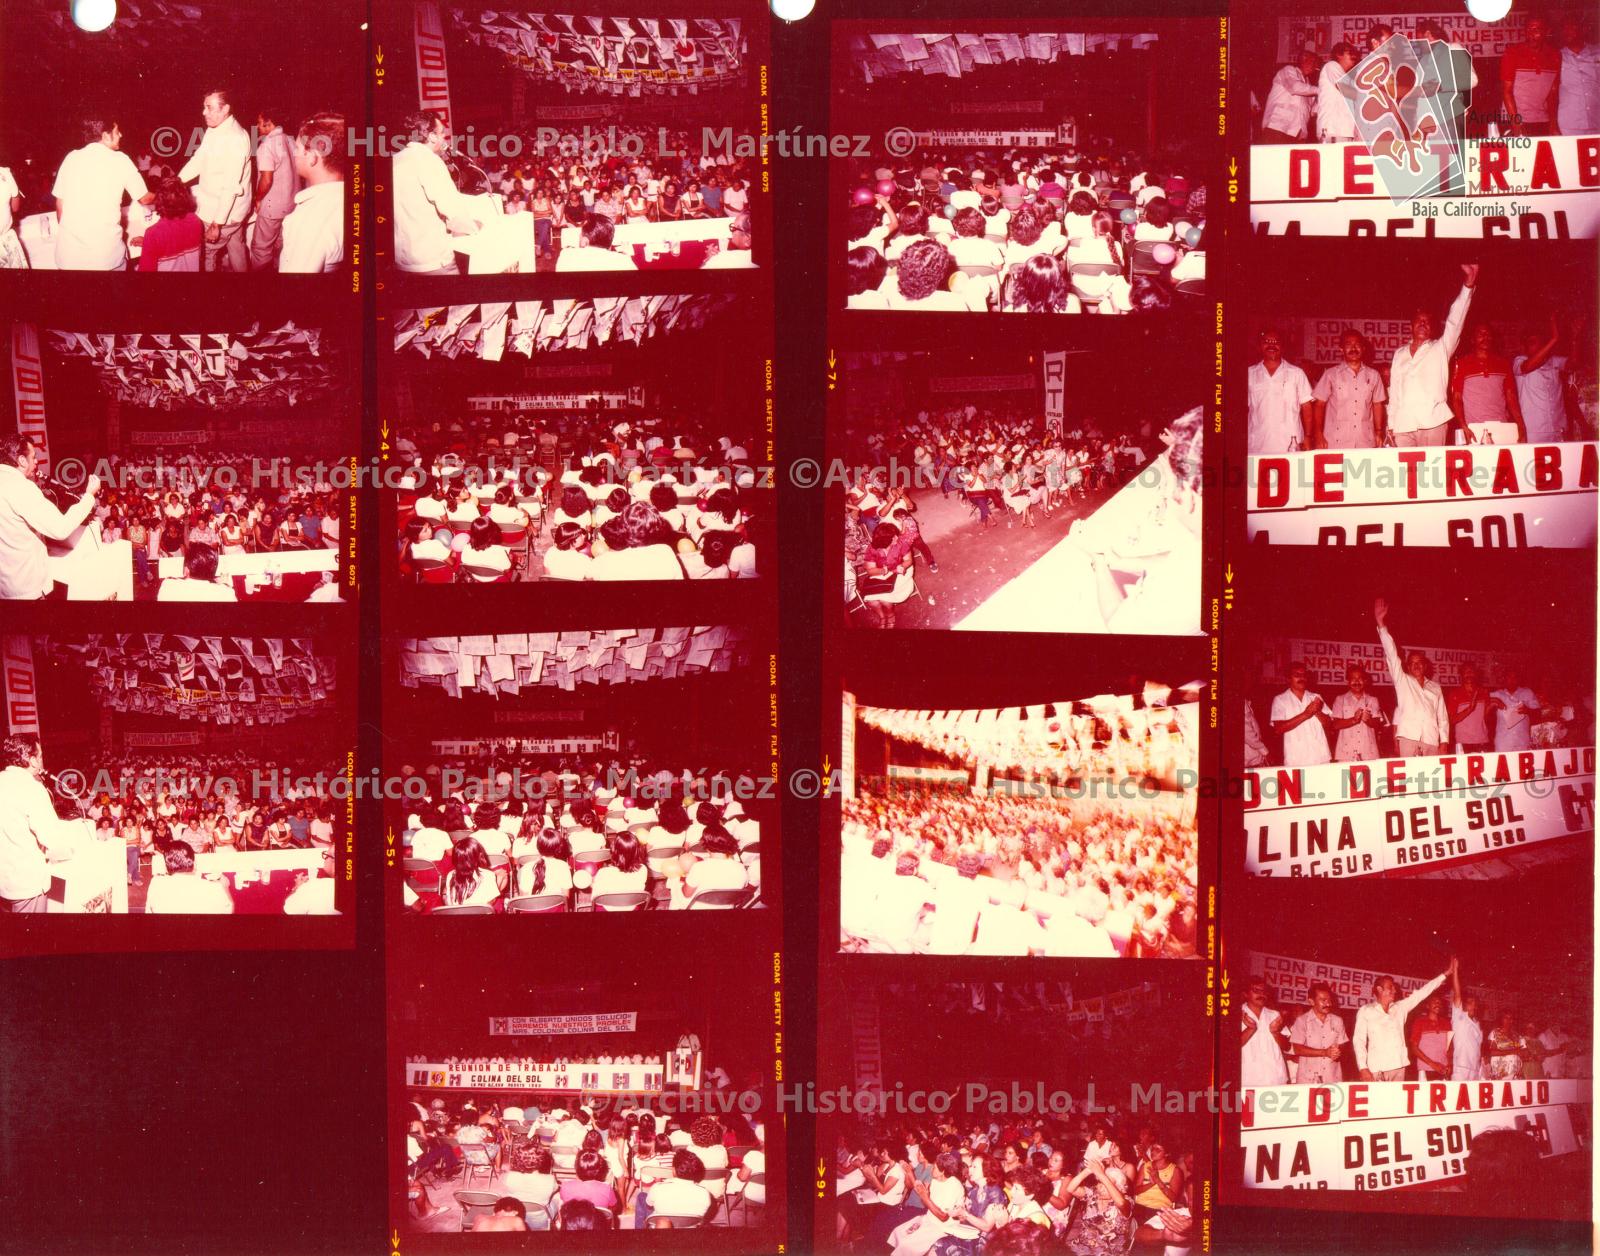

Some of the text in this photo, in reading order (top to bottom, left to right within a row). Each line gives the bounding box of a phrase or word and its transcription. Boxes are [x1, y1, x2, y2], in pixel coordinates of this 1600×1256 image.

[1391, 15, 1476, 29] ALRTO
[1219, 46, 1227, 81] SAFETY
[760, 65, 769, 193] KODAK SAFETY FILM 6075
[1218, 114, 1226, 136] 6075
[1289, 146, 1374, 198] DE
[352, 244, 360, 265] FILM
[1215, 341, 1223, 377] SAFETY
[1215, 383, 1223, 405] FILM
[765, 399, 773, 433] SAFETY
[1257, 453, 1344, 508] DE
[349, 495, 357, 530] SAFETY
[1211, 598, 1219, 630] KODAK
[769, 655, 777, 686] KODAK
[1211, 637, 1219, 672] SAFETY
[1349, 760, 1407, 799] DE
[1440, 748, 1595, 787] TRABAJO
[1385, 805, 1453, 843] DEL
[1466, 795, 1524, 830] SOL
[1397, 838, 1467, 864] AGOSTO
[1483, 828, 1526, 848] 1980
[345, 859, 353, 881] 6075
[1206, 966, 1214, 989] FILM
[773, 952, 783, 1081] KODAK SAFETY FILM 6075
[1206, 994, 1214, 1017] 6075
[448, 1064, 567, 1072] REUNION DE TRABAJO
[1308, 1081, 1550, 1123] DE TRABAJO
[1344, 1131, 1413, 1169] DEL
[1355, 1165, 1426, 1191] AGOSTO
[1202, 1180, 1211, 1253] KODAK SAFETY
